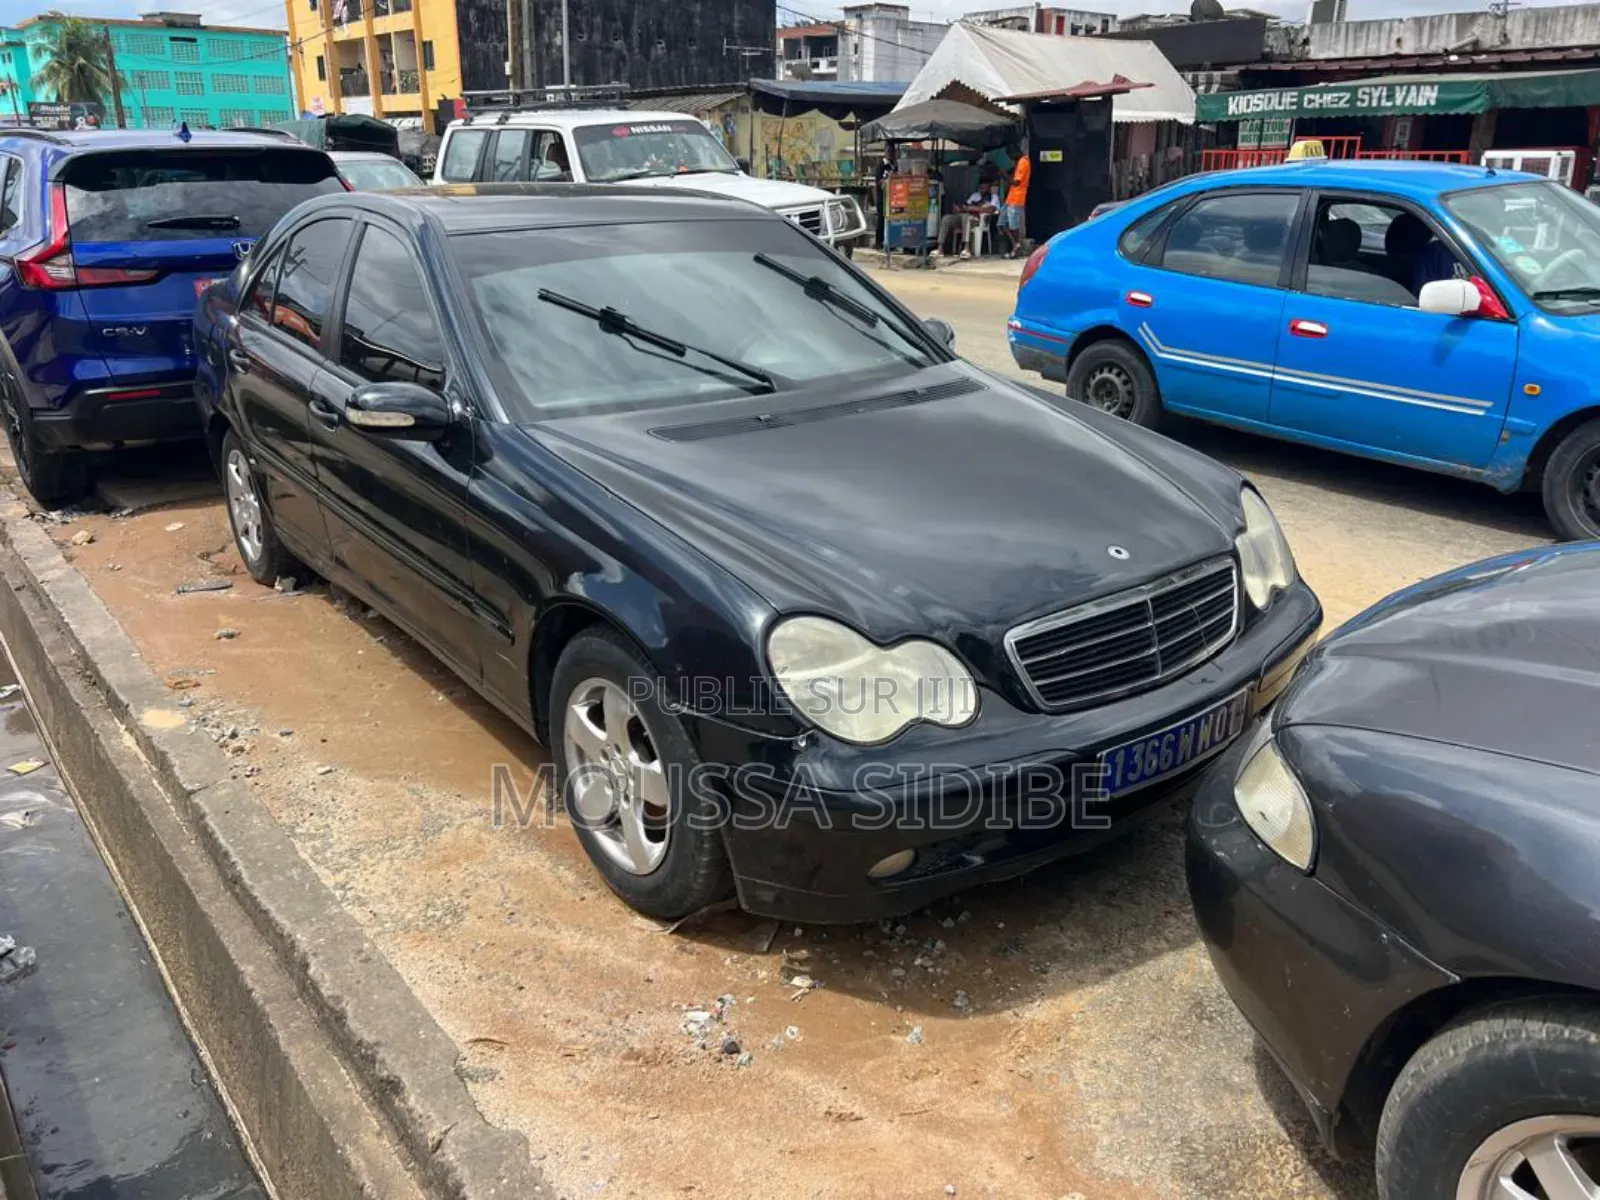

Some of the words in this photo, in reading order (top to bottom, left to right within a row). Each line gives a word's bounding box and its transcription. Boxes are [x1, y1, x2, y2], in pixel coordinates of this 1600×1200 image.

[1228, 91, 1298, 115] KIOSQUE
[1303, 92, 1351, 109] CHEZ
[1356, 85, 1439, 108] SYLVAIN
[630, 124, 672, 134] NISSAN
[1304, 141, 1324, 157] TAXI
[102, 326, 147, 336] CR-V
